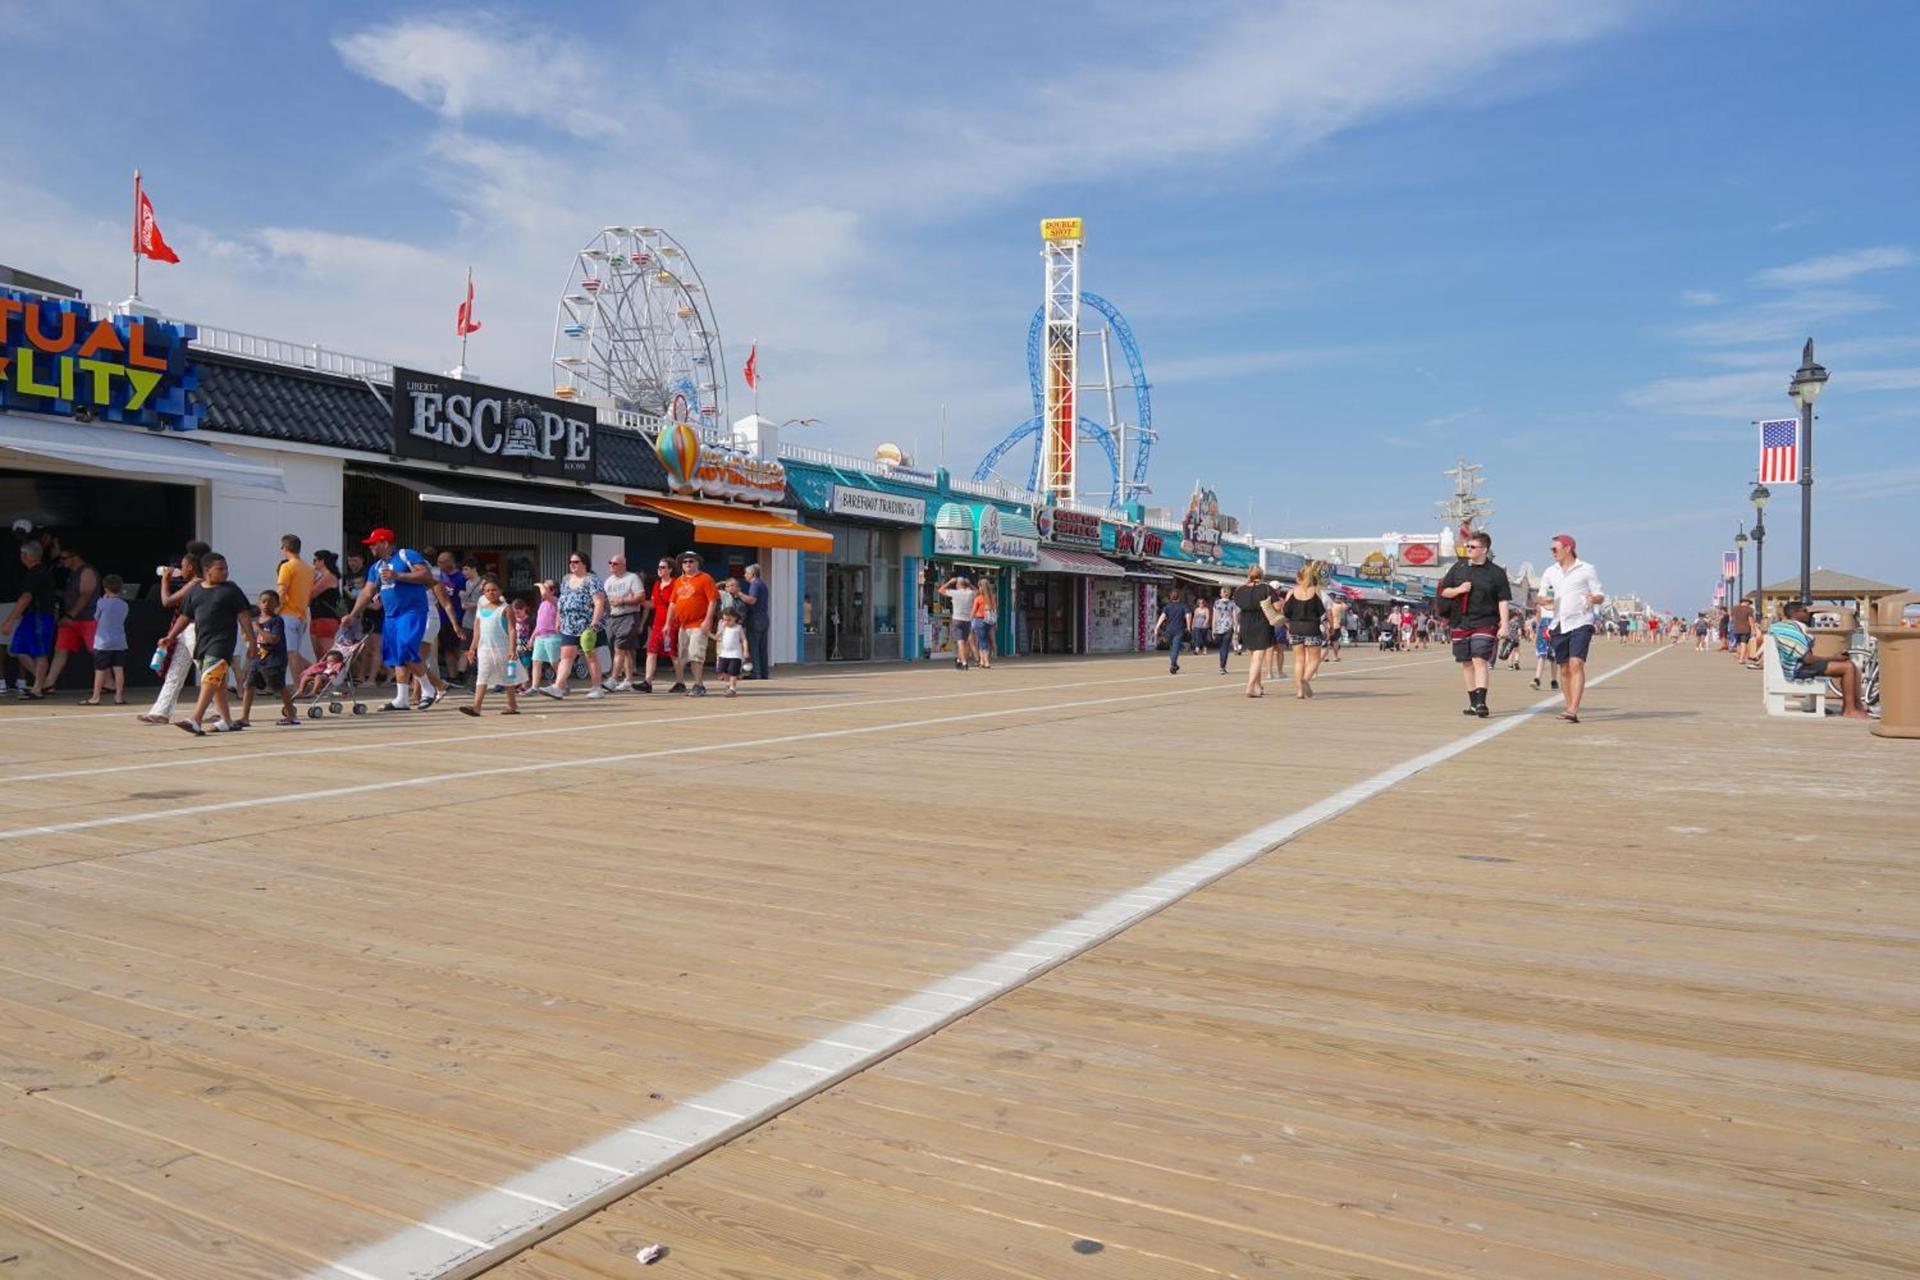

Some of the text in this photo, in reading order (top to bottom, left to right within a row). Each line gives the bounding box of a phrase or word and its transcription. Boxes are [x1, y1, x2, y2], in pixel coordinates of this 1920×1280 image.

[1046, 221, 1077, 229] DOUBLE
[1050, 229, 1072, 237] SHOT
[0, 347, 163, 411] LITY
[406, 381, 439, 393] LIBERTY
[842, 493, 878, 512] BAREFOOT
[879, 498, 906, 516] TRADING
[1053, 509, 1100, 526] OCEAN CITY
[1054, 521, 1087, 535] COFFEE
[1187, 524, 1220, 545] T-SHIRT
